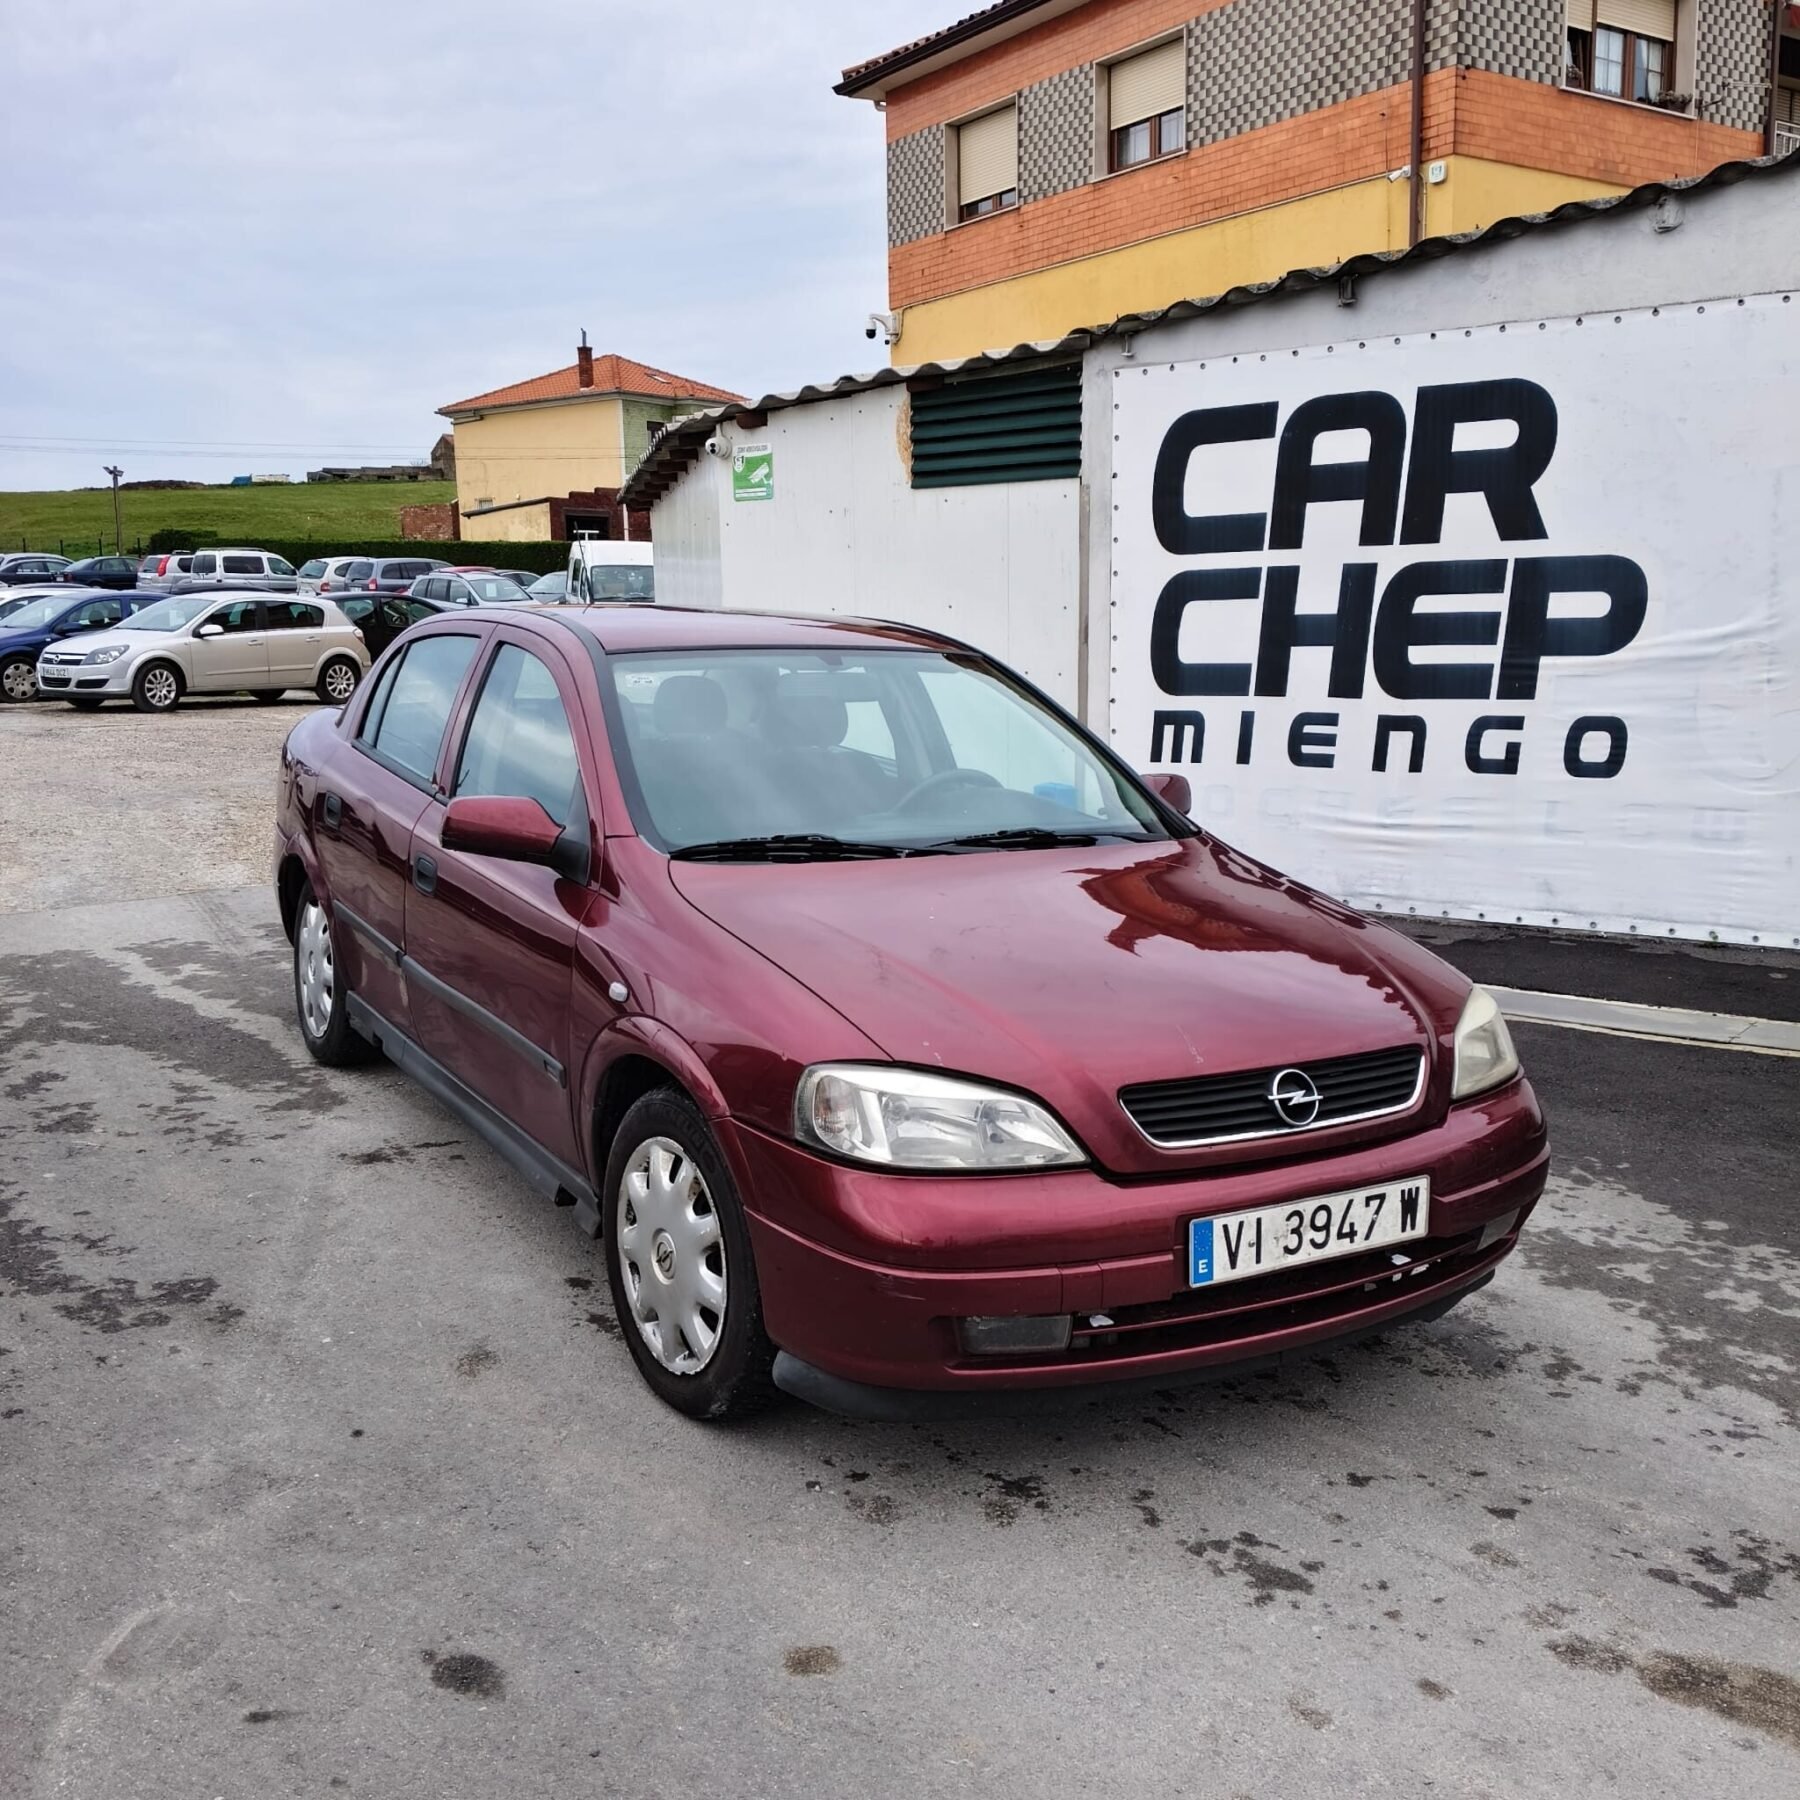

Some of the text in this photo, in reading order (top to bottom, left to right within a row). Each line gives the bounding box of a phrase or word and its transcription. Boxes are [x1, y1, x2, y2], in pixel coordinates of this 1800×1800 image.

[1152, 377, 1558, 556] CAR
[1150, 554, 1649, 700] CHEP
[1149, 710, 1628, 779] MIENGO
[1198, 1259, 1208, 1273] E
[1222, 1186, 1420, 1270] VI 3947 W
